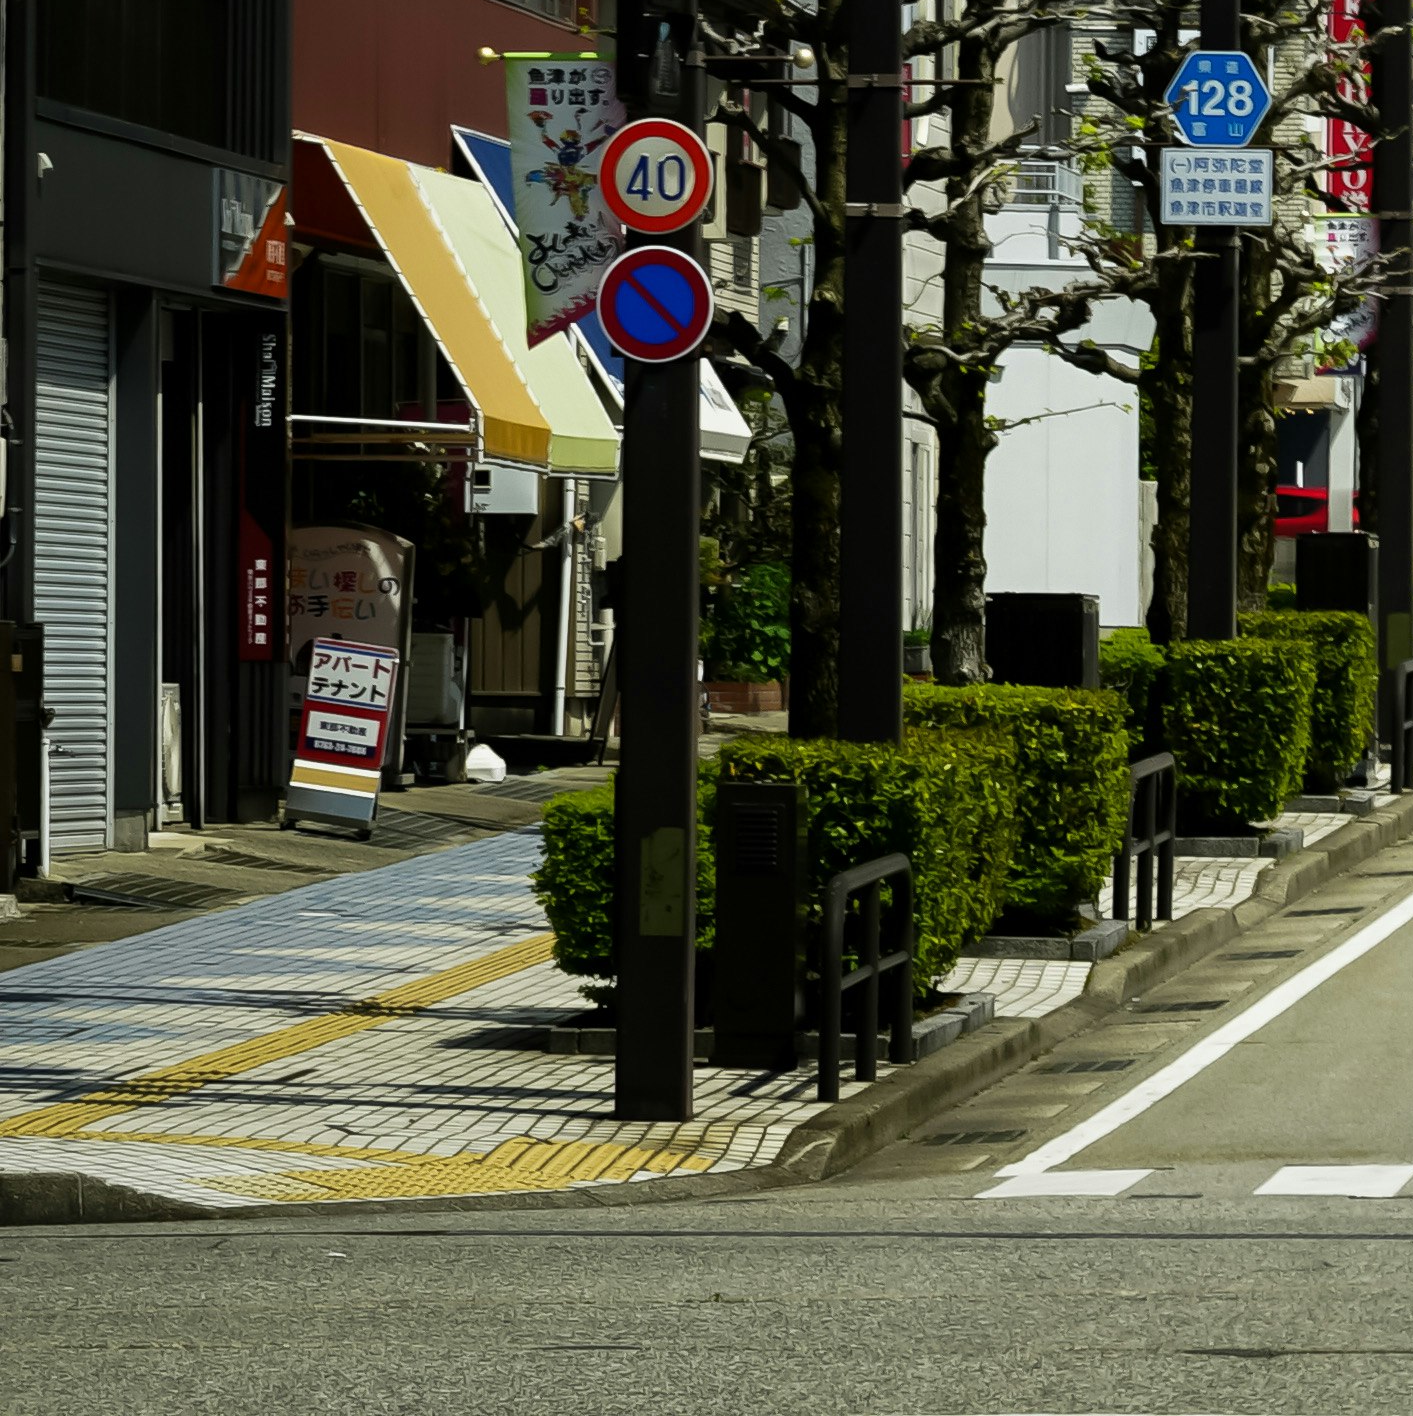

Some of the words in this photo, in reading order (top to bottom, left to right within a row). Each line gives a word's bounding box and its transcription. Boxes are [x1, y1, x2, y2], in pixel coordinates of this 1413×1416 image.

[1182, 79, 1254, 117] 128
[1192, 122, 1244, 136] 富山
[626, 153, 686, 202] 40
[314, 652, 391, 679] アパート
[311, 676, 386, 703] テナント
